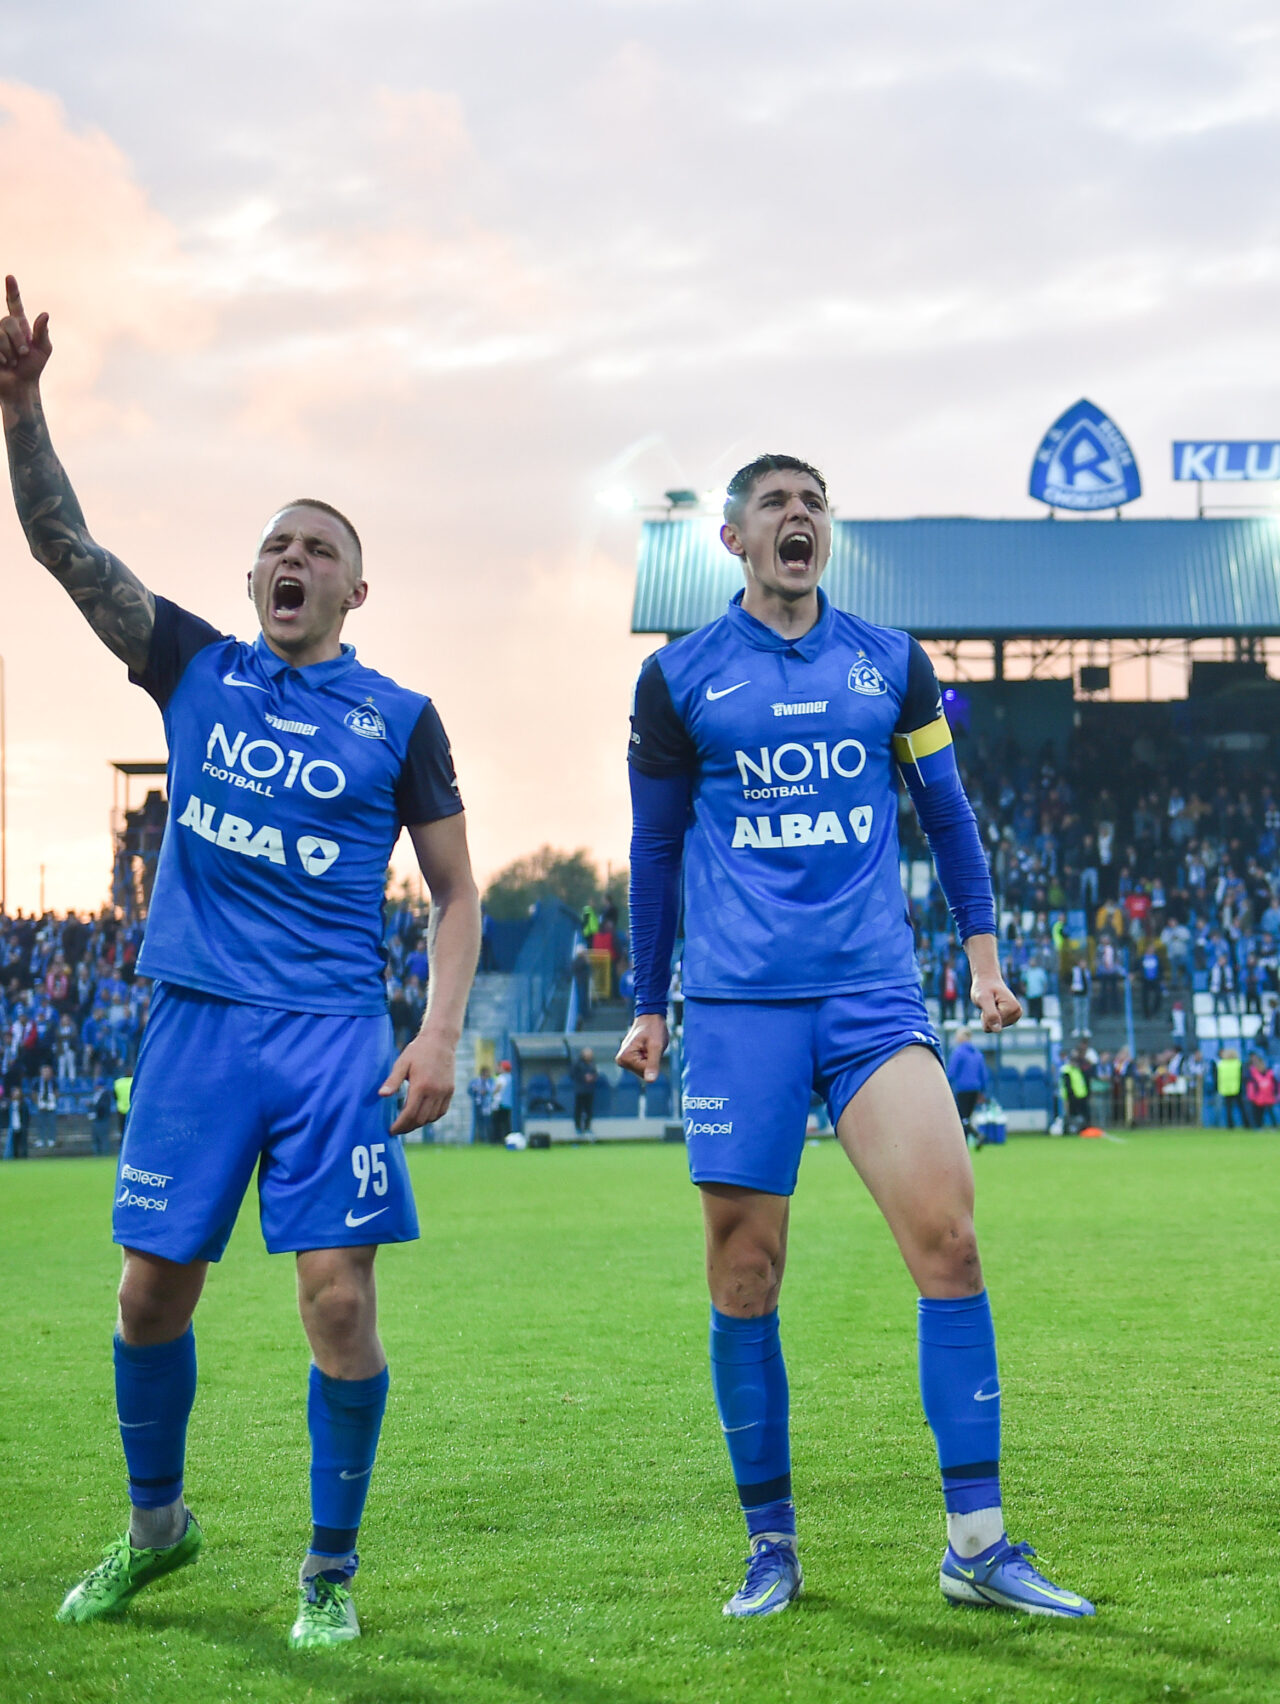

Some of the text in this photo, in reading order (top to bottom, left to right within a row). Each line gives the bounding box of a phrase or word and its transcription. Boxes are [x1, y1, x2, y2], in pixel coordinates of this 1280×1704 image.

[770, 700, 829, 716] ewinner
[206, 722, 346, 799] NO10
[735, 738, 866, 786] NO10
[201, 761, 275, 798] FOOTBALL
[743, 784, 818, 800] FOOTBALL
[176, 794, 287, 866] ALBA
[731, 811, 848, 849] ALBA
[693, 1121, 733, 1136] pepsi
[351, 1143, 389, 1199] 95
[128, 1194, 168, 1212] pepsi
